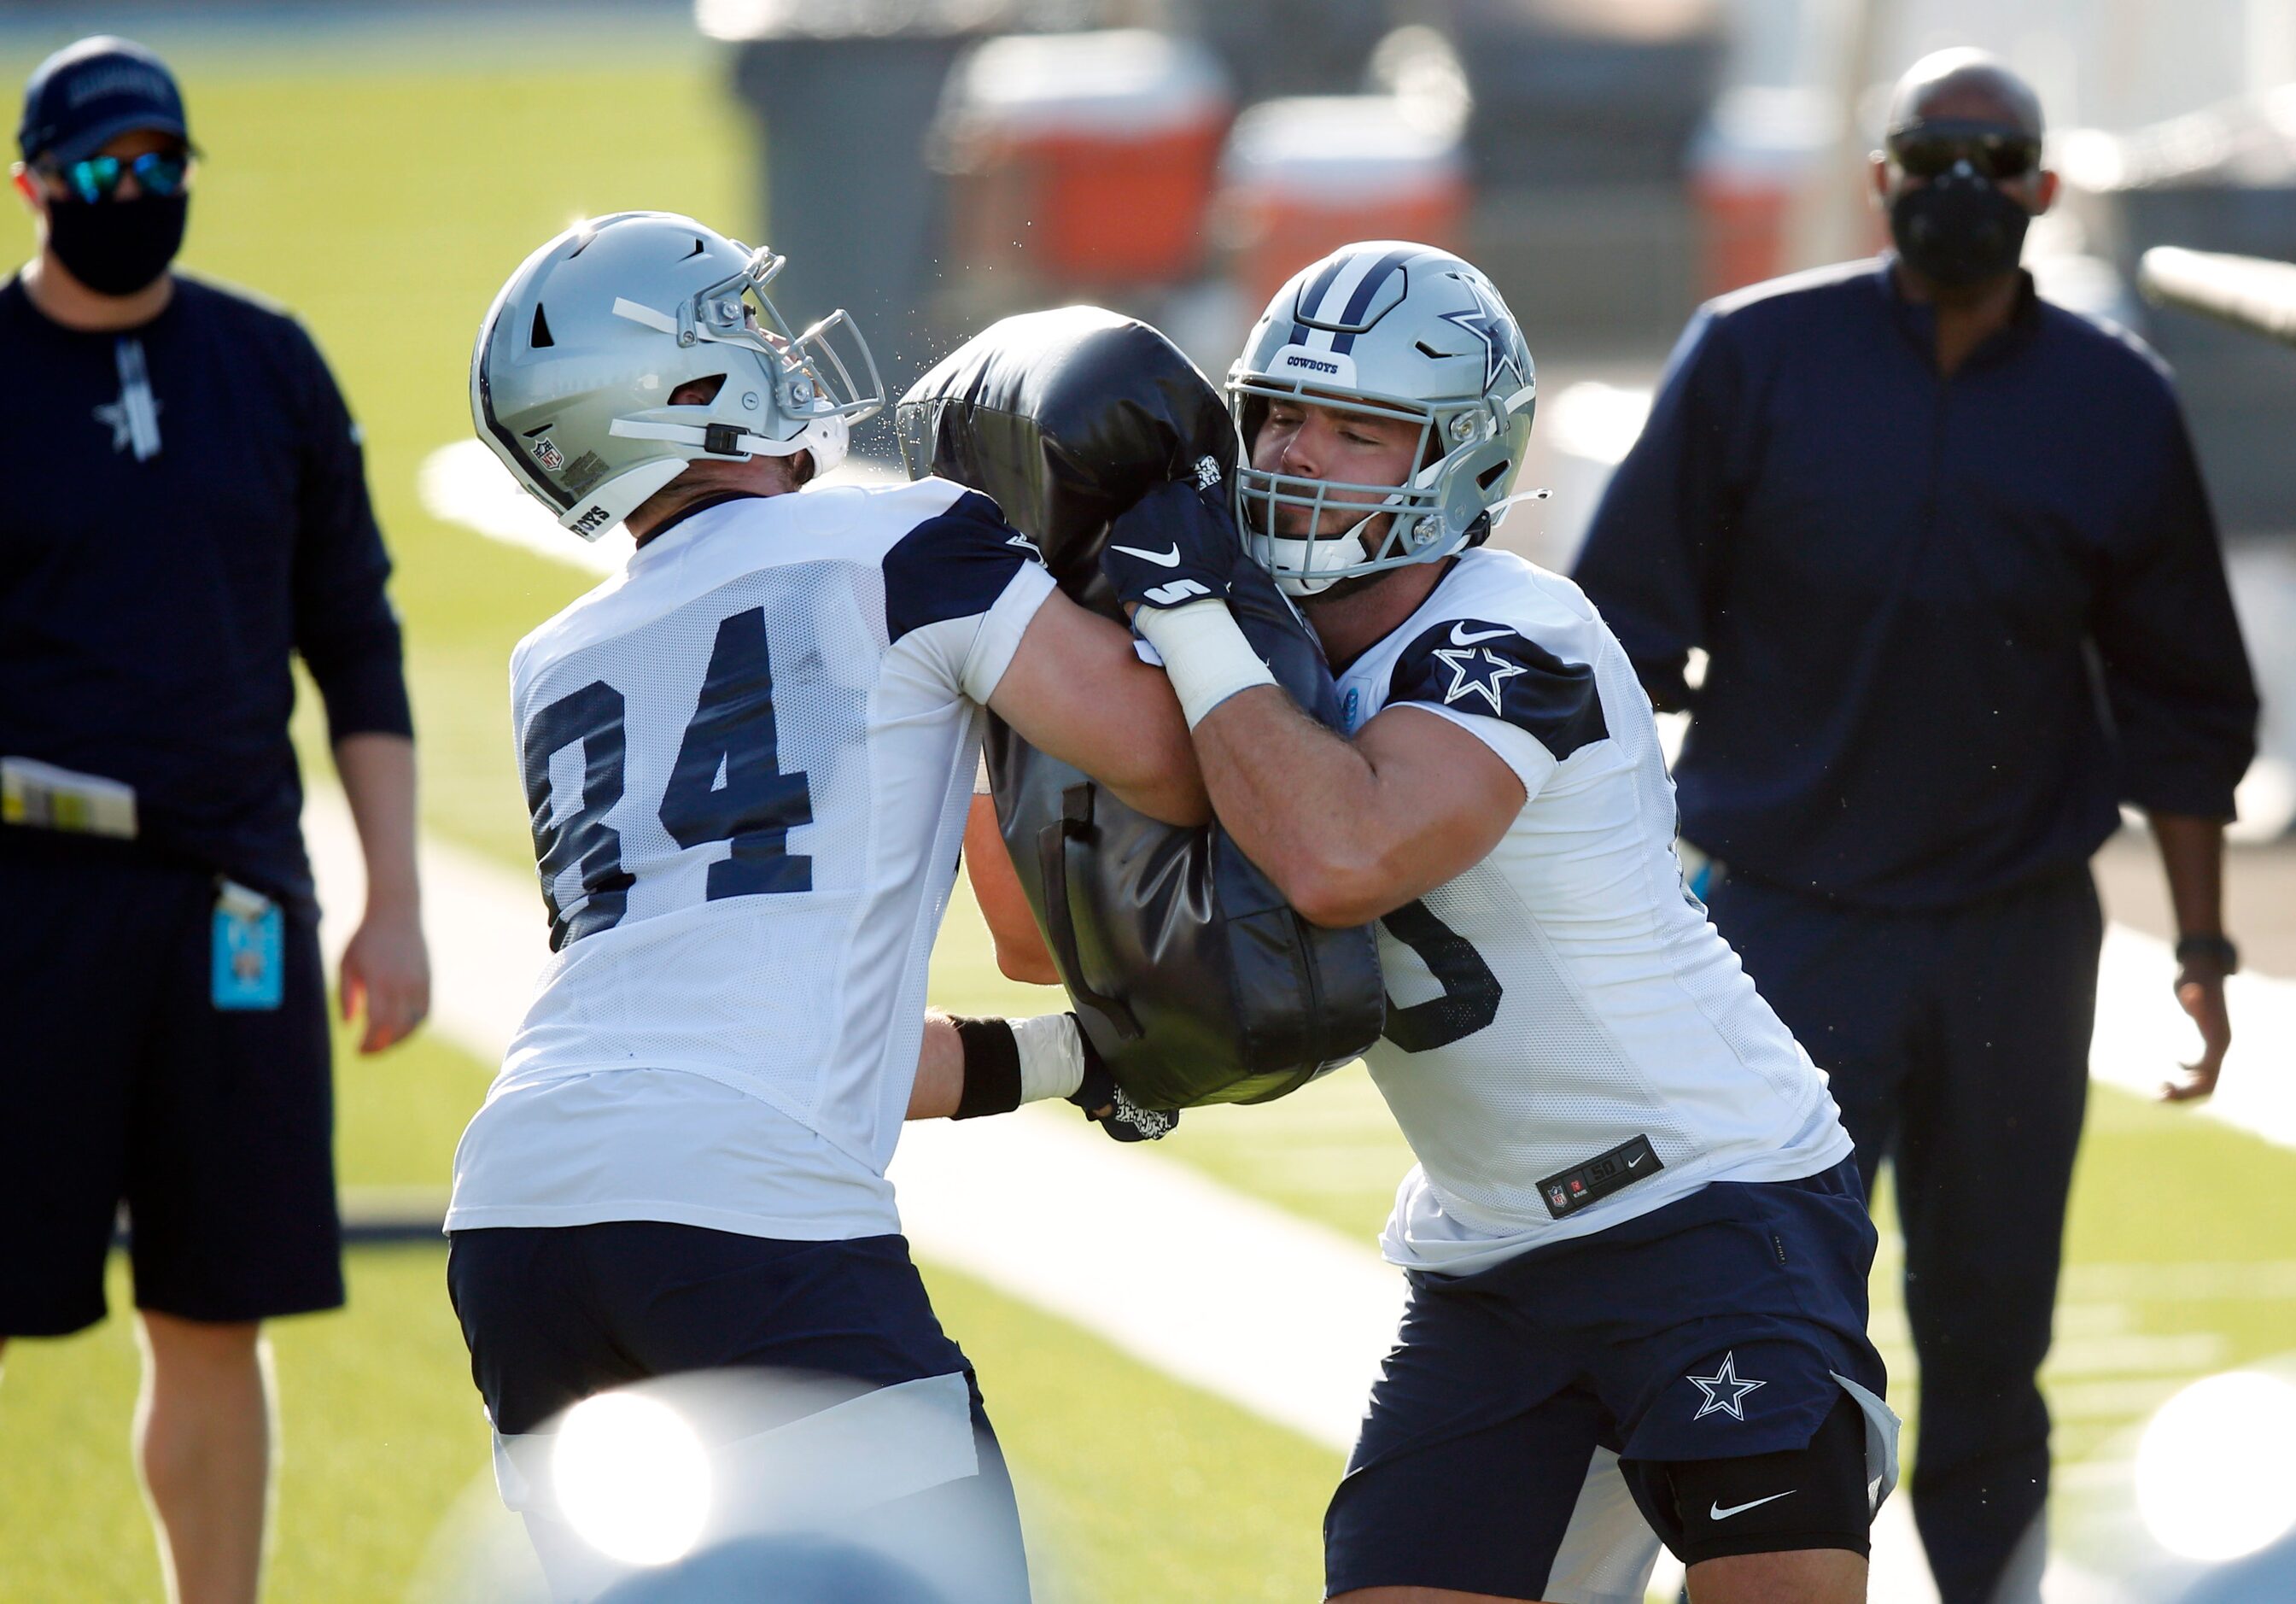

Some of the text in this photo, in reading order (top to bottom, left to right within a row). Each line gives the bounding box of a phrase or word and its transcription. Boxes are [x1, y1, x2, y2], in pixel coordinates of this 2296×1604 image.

[1288, 356, 1338, 374] COWBOYS
[523, 606, 814, 953] 84
[1591, 1159, 1616, 1181] 50
